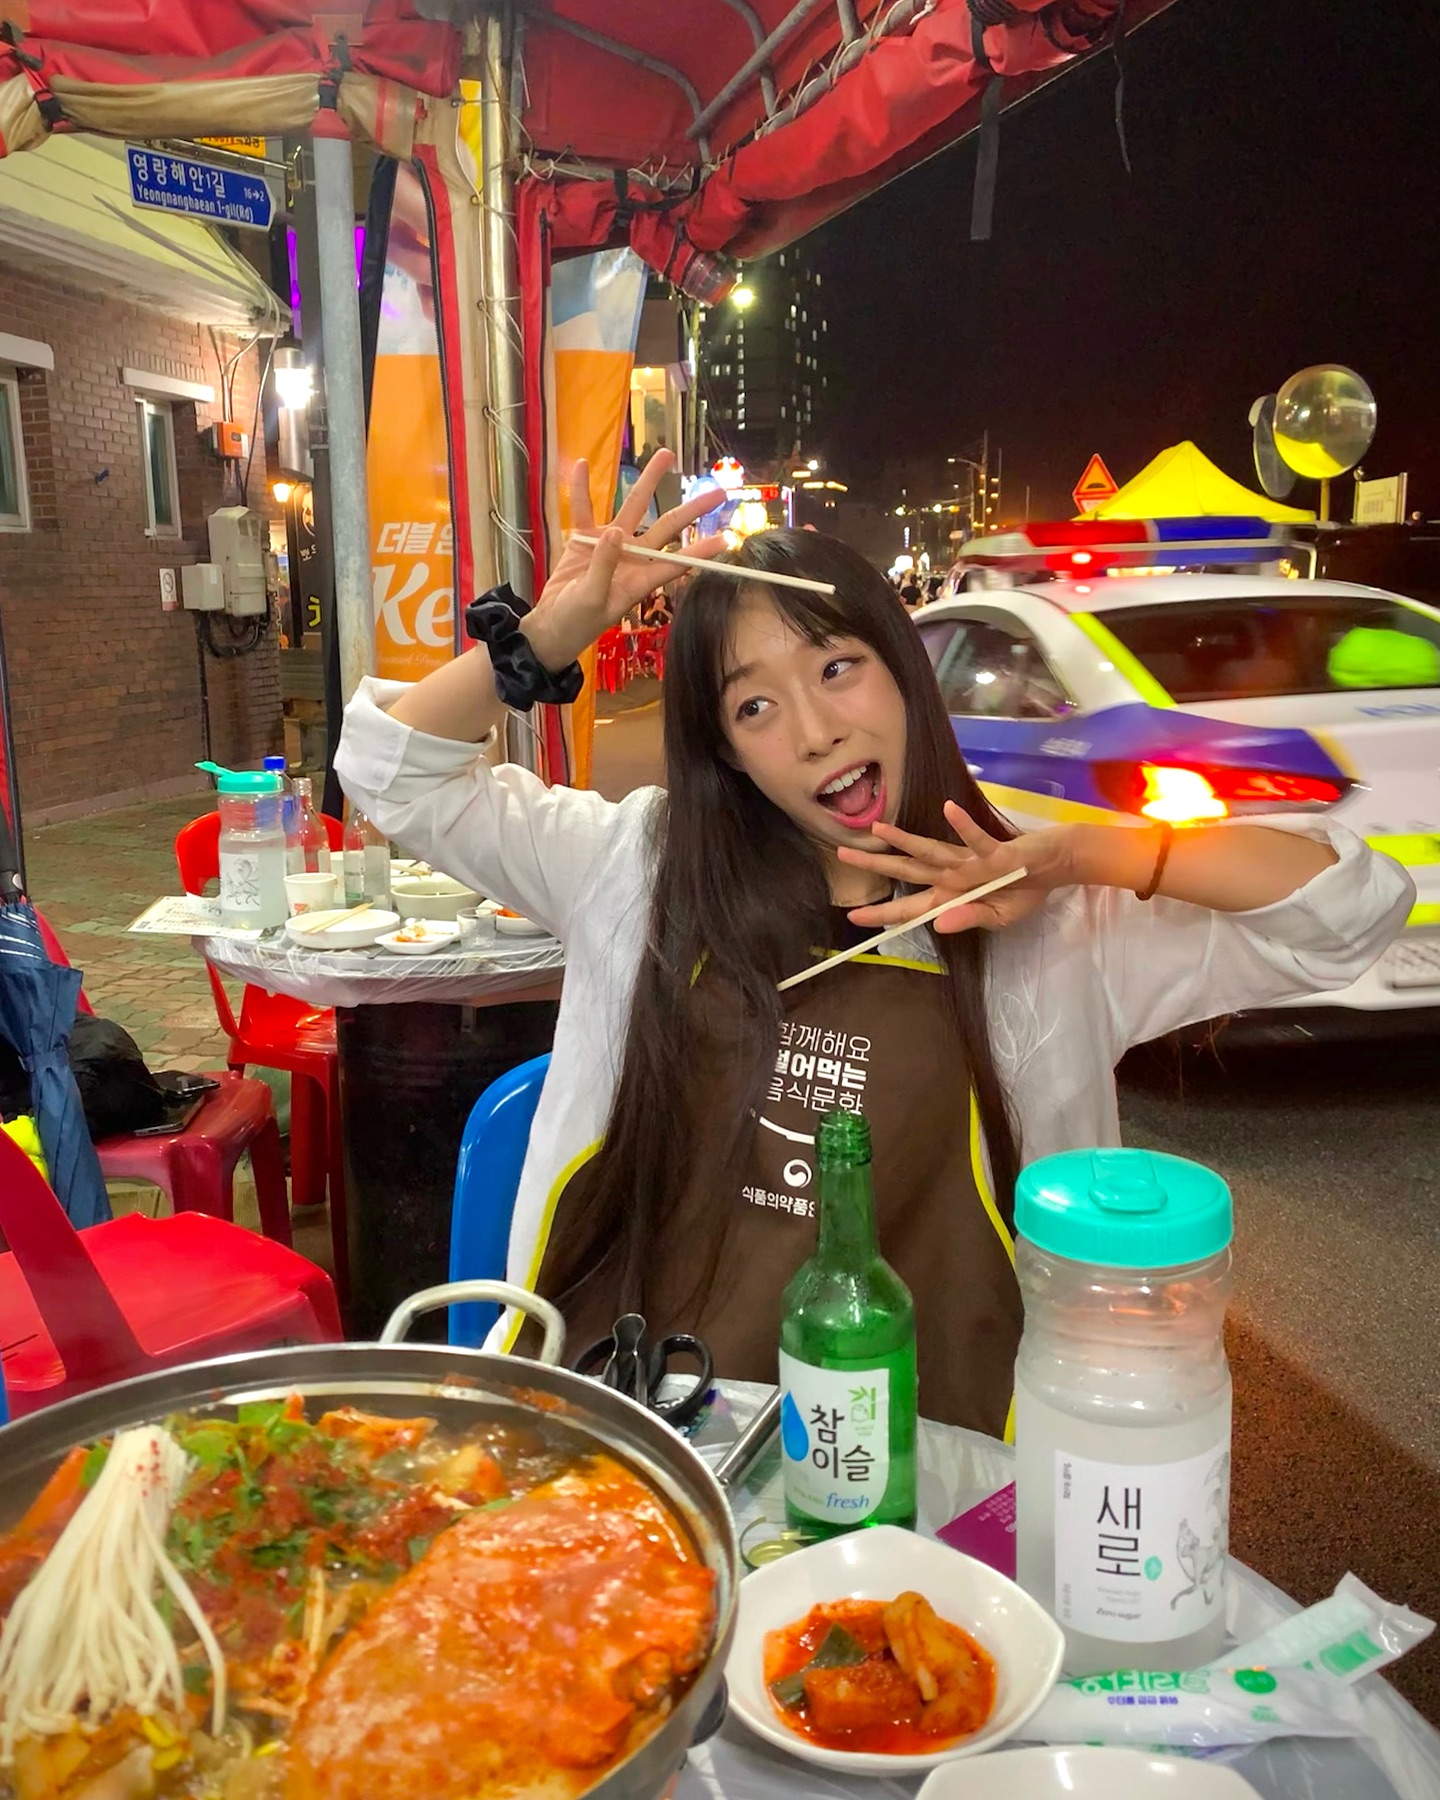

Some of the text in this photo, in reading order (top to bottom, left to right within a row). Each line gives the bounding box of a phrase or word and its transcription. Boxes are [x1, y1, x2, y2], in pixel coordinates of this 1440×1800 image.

[132, 153, 226, 199] 영랑해안1길
[136, 183, 215, 213] Yeongnanghaean
[376, 521, 436, 554] 더블
[779, 1022, 872, 1062] 함께해요
[810, 1404, 845, 1445] 참
[812, 1445, 875, 1482] 이슬
[825, 1492, 869, 1509] fresh
[1096, 1485, 1141, 1577] 새로
